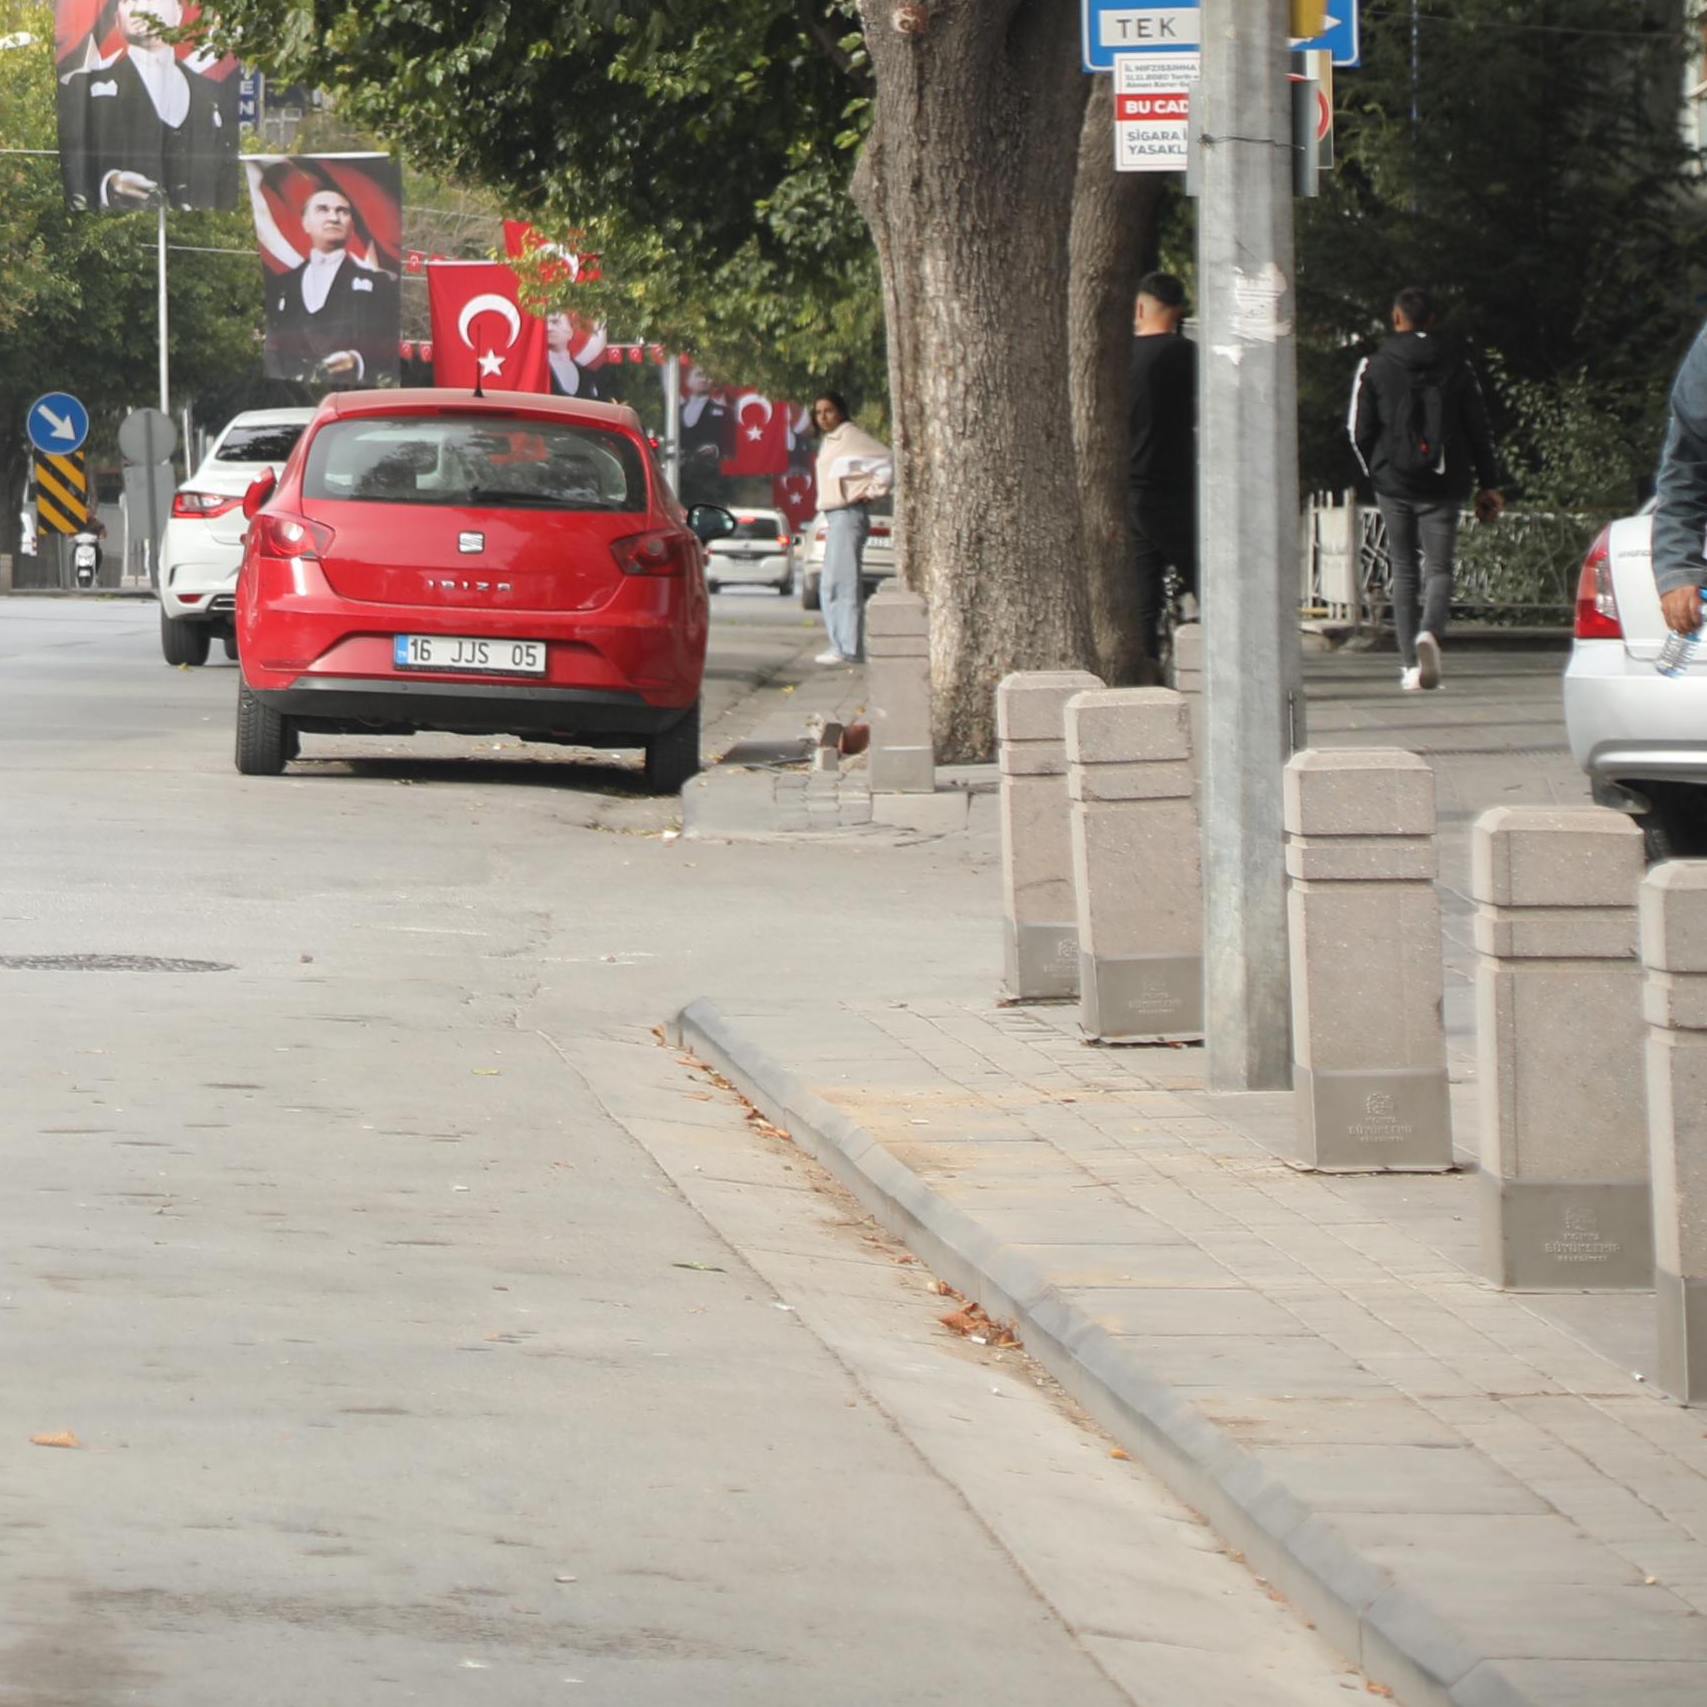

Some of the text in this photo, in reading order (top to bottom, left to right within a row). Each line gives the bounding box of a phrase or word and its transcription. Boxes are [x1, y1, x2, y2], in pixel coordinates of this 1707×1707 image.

[1116, 17, 1177, 39] TEK
[1125, 99, 1189, 114] BU CAD
[1127, 128, 1181, 142] SİGARA
[1128, 144, 1188, 155] YASAKL
[411, 639, 538, 667] 16 JJS 05
